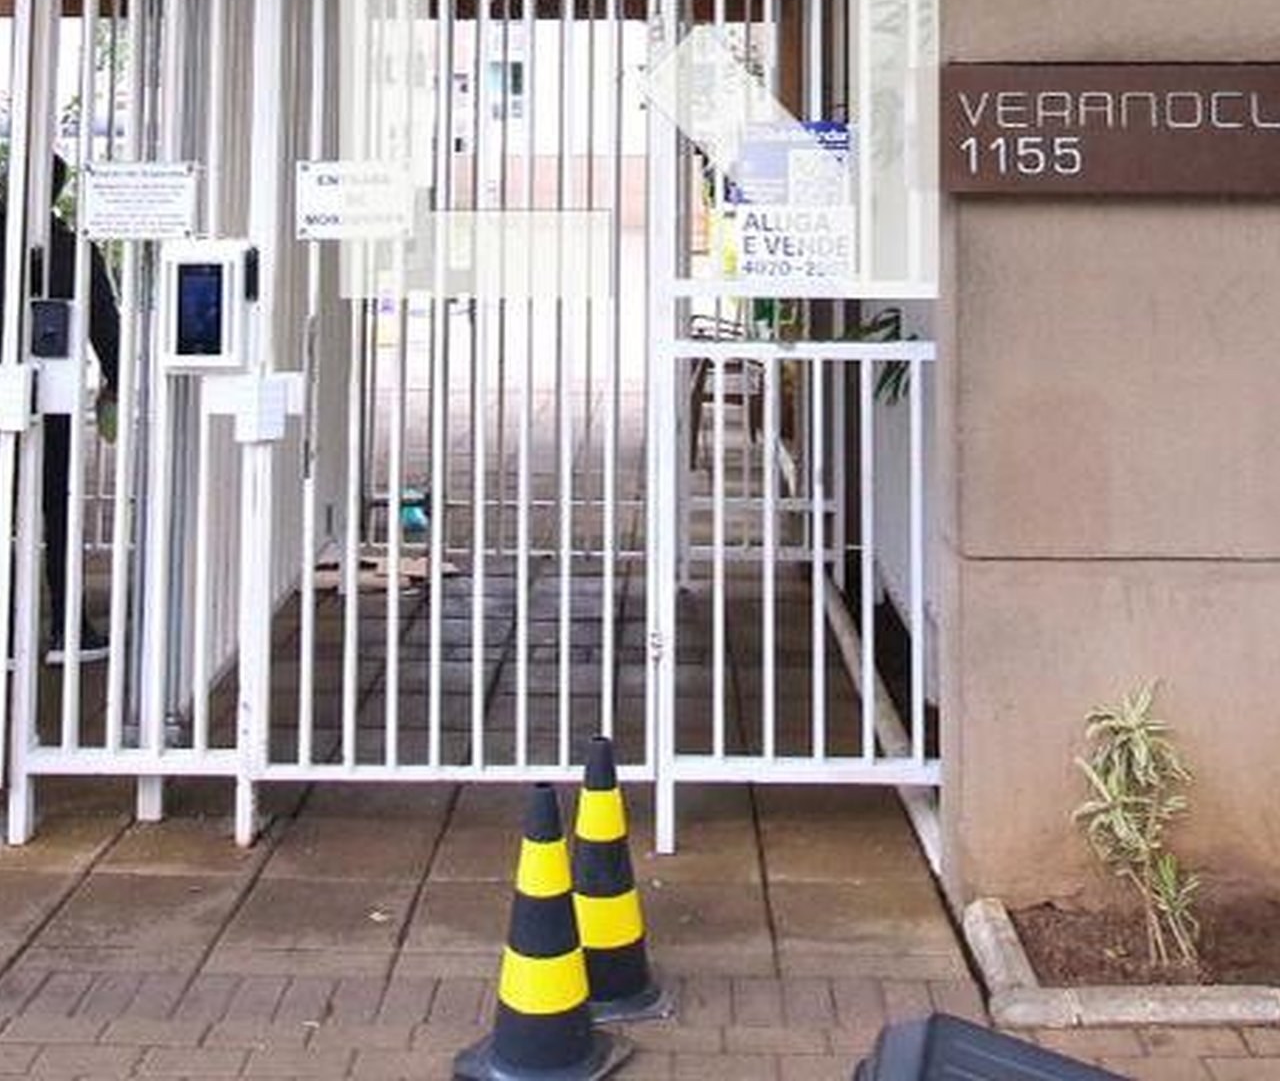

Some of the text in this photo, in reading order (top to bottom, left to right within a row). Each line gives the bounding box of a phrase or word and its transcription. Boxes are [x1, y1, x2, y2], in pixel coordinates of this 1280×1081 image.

[959, 136, 1082, 174] 1155
[742, 211, 831, 233] ALUGA
[743, 235, 850, 258] E VENDE
